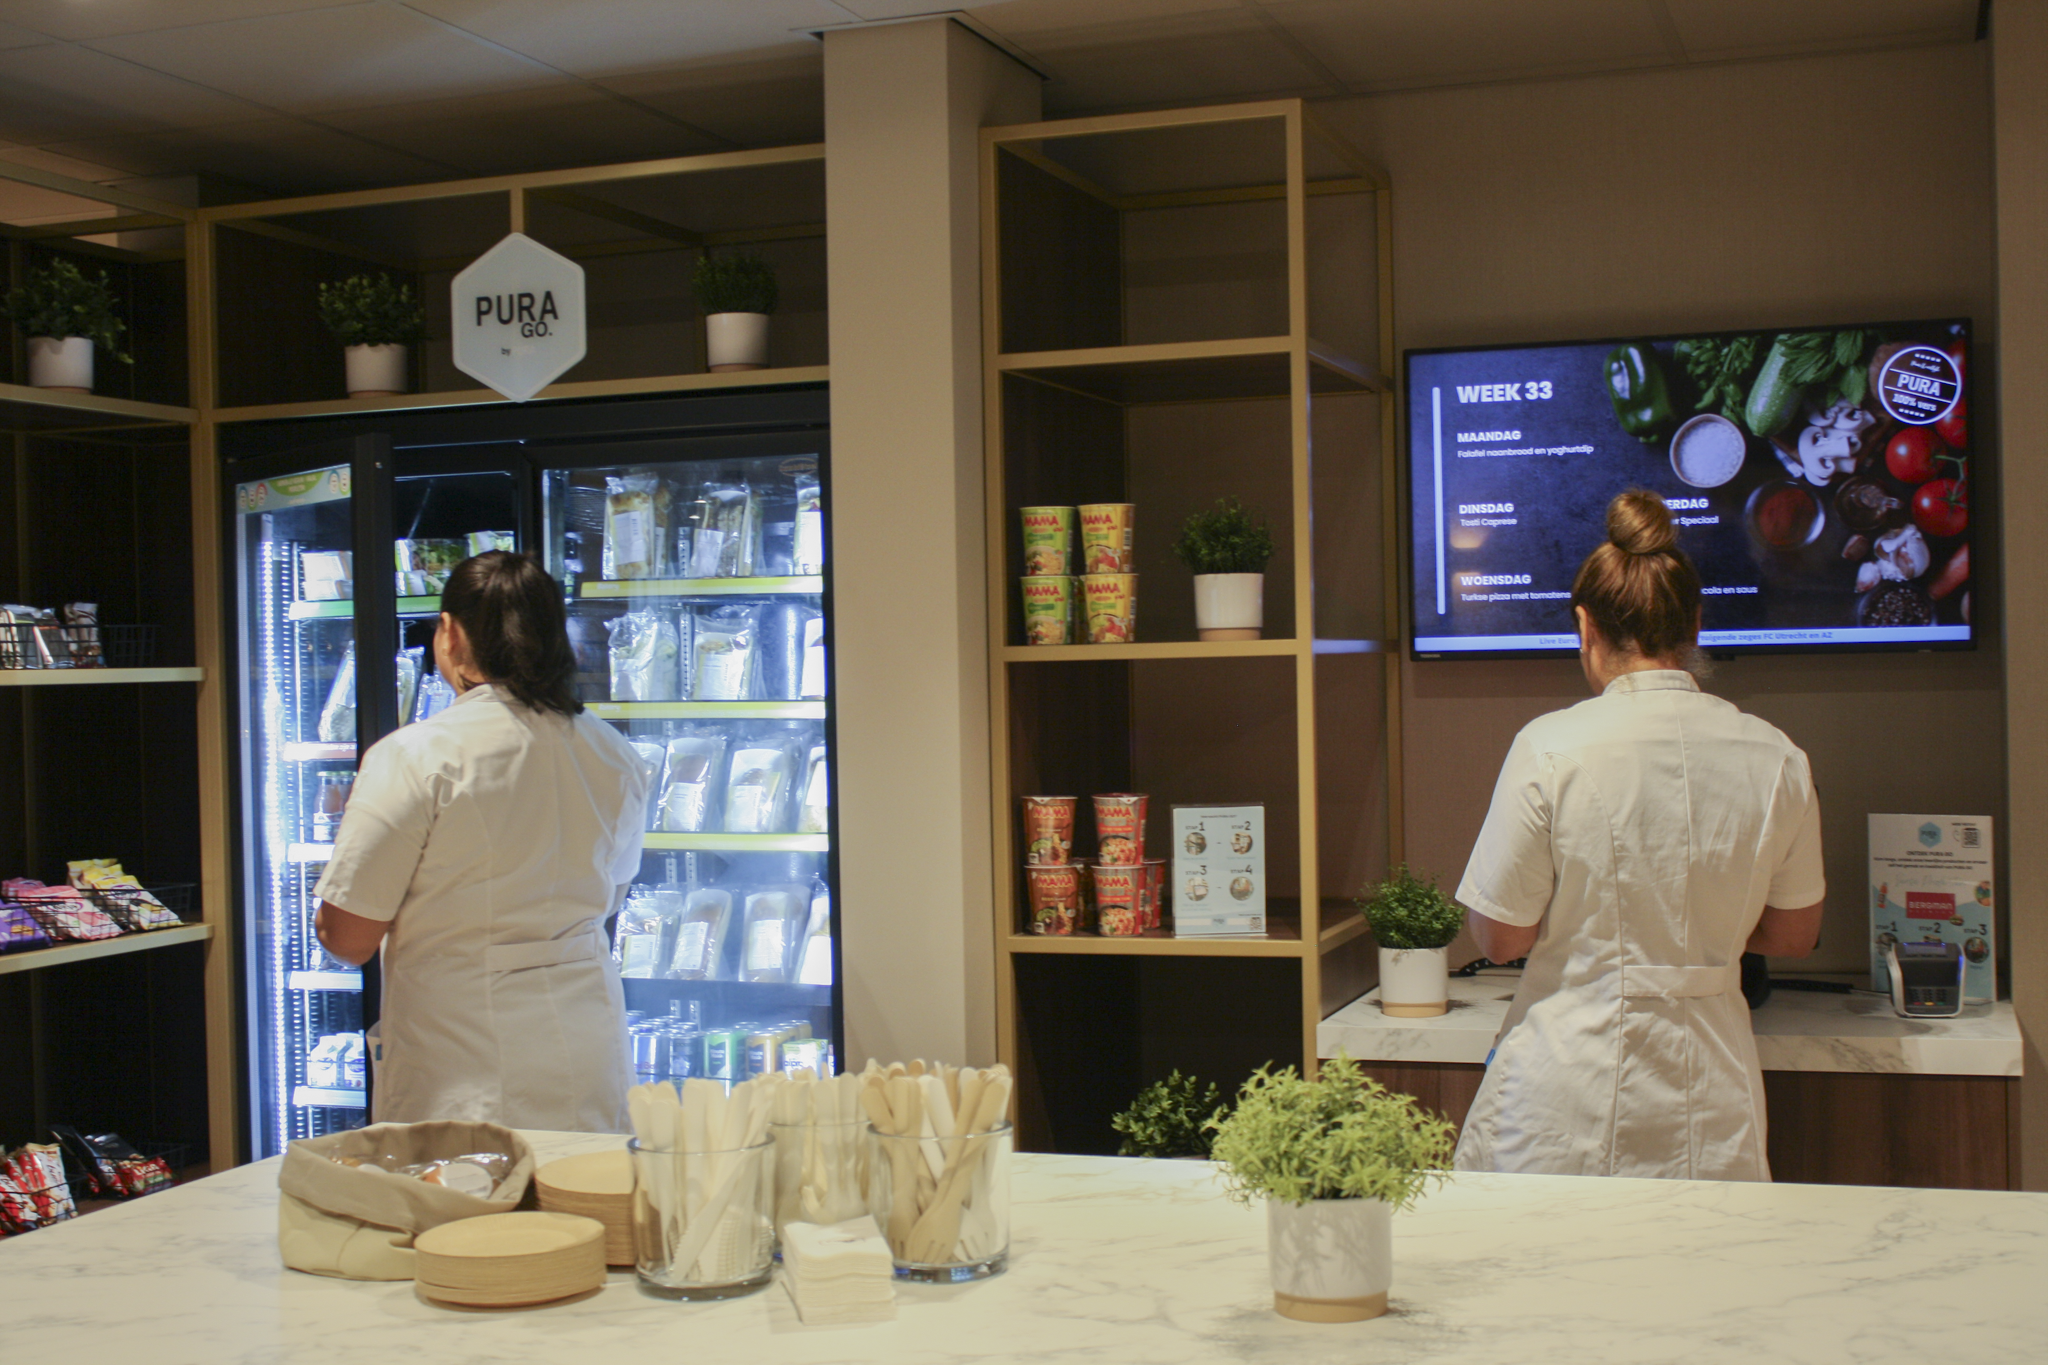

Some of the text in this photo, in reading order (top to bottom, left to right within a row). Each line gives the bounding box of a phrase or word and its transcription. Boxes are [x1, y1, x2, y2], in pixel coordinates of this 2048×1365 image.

[476, 290, 559, 327] PURA
[521, 321, 553, 338] GO.
[1897, 374, 1941, 397] PURA
[1456, 381, 1553, 403] WEEK 33
[1457, 430, 1522, 443] MAANDAG
[1457, 444, 1594, 458] Falafel naanbrood en yoghurtdip
[1459, 503, 1515, 515] DINSDAG
[1024, 515, 1060, 527] MAMA
[1082, 513, 1114, 525] MAMA
[1460, 518, 1518, 528] Tosti Caprese
[1680, 515, 1720, 527] Speciaal
[1461, 574, 1532, 586] WOENSDAG
[1026, 585, 1061, 597] MAMA
[1086, 582, 1121, 595] MAMA
[1723, 586, 1735, 594] en
[1736, 586, 1759, 594] saus
[1461, 593, 1488, 601] Turkse
[1488, 592, 1510, 602] pizza
[1511, 592, 1529, 600] met
[1763, 632, 1774, 640] FC
[1775, 631, 1808, 640] Utrecht
[1821, 631, 1834, 639] AZ
[1033, 805, 1070, 819] MAMA
[1098, 805, 1134, 818] MAMA
[1199, 821, 1206, 832] 1
[1244, 820, 1252, 831] 2
[1200, 864, 1208, 876] 3
[1245, 864, 1253, 875] 4
[1037, 874, 1075, 888] MAMA
[1097, 876, 1133, 888] MAMA
[1890, 920, 1898, 932] 1
[1933, 921, 1942, 934] 2
[1979, 923, 1988, 936] 3
